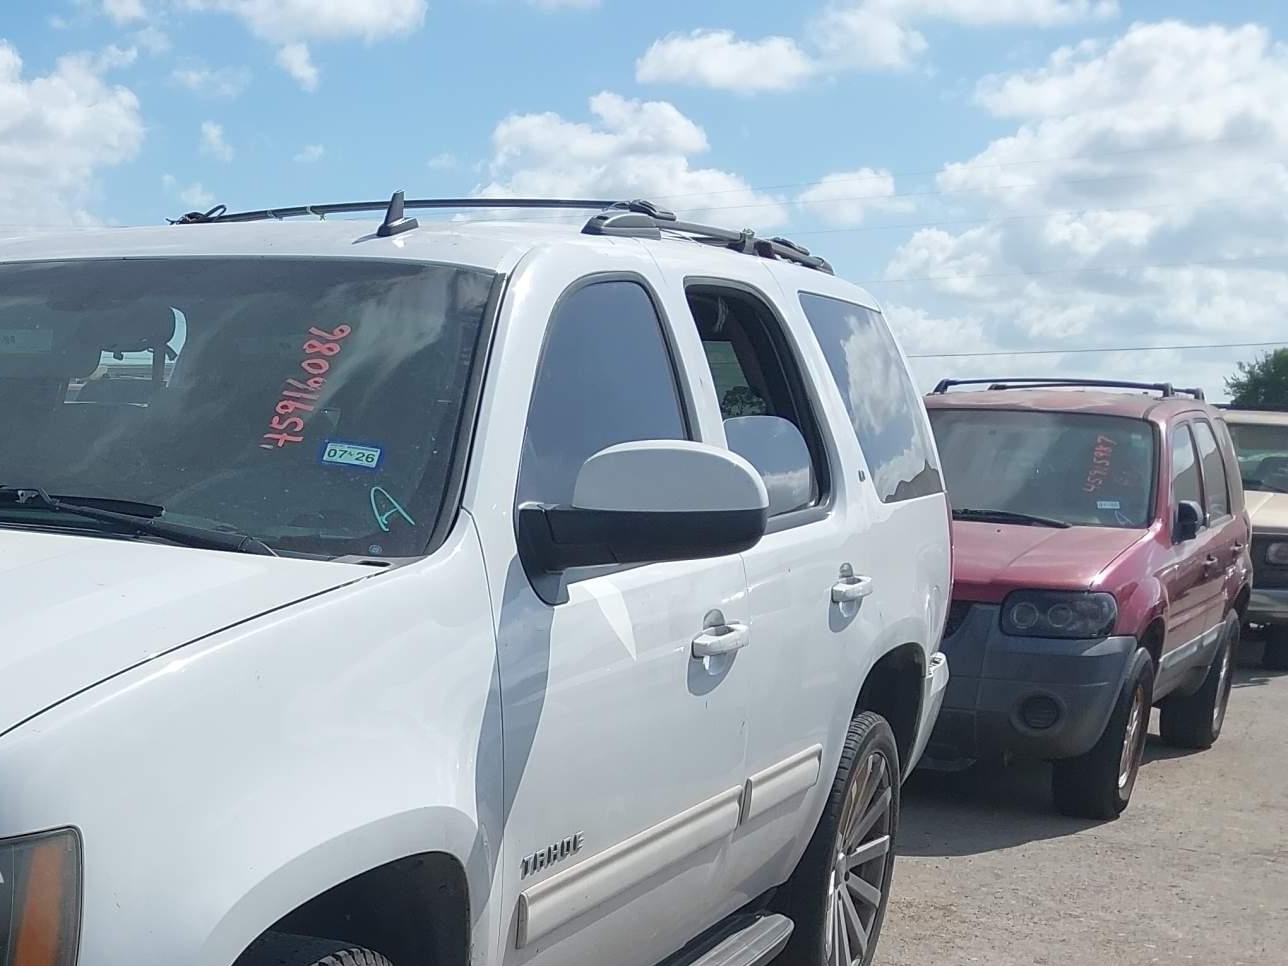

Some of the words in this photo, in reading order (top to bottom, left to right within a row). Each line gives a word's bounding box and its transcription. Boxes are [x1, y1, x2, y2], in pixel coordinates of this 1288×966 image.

[259, 323, 352, 450] 45916086
[327, 448, 348, 459] 07
[354, 451, 376, 463] 26
[370, 486, 415, 531] A
[520, 830, 585, 880] TAHOE
